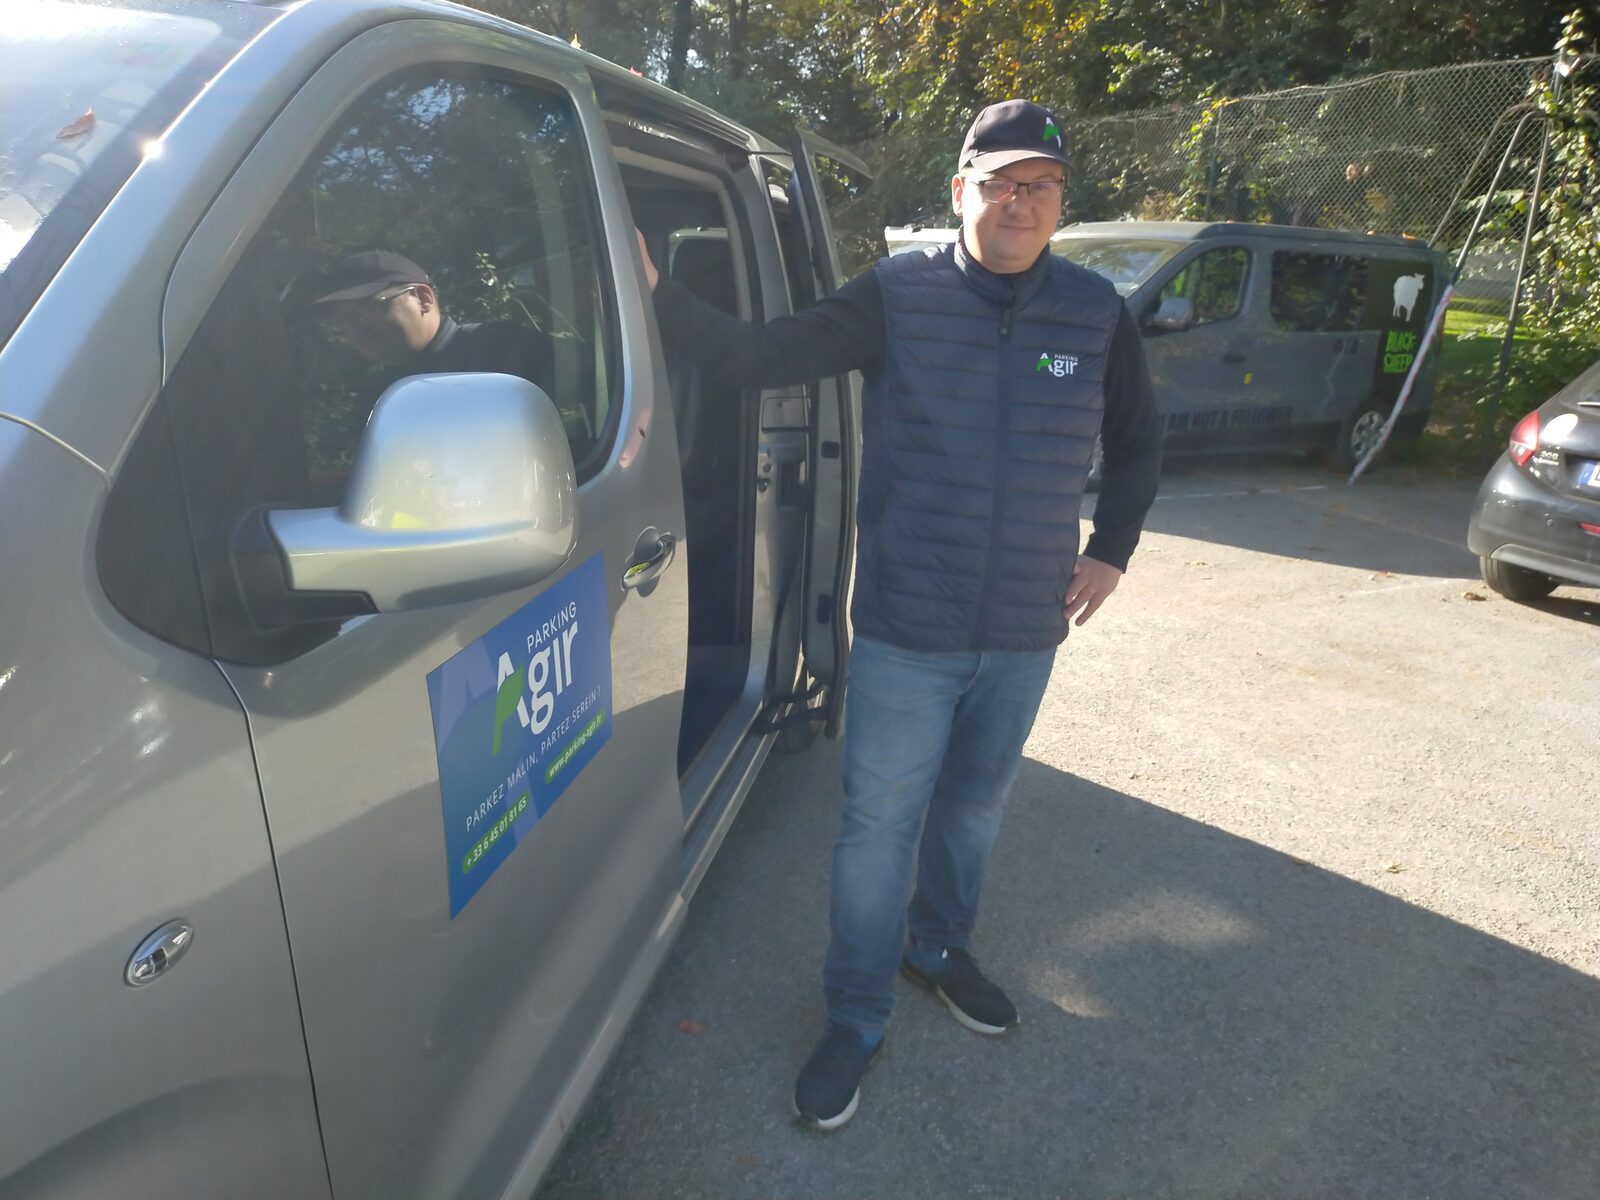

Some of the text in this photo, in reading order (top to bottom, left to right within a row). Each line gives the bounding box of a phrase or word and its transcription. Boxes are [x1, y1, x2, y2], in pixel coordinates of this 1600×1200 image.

[1035, 352, 1079, 377] Agir
[1054, 353, 1079, 361] PARKING
[526, 601, 577, 654] PARKING
[493, 620, 579, 755] Agir
[465, 783, 504, 832] PARKEZ
[507, 752, 539, 790] MALIN,
[540, 716, 570, 756] PARTEZ
[572, 689, 597, 724] SEREIN
[473, 844, 482, 862] 33
[483, 837, 489, 850] 6
